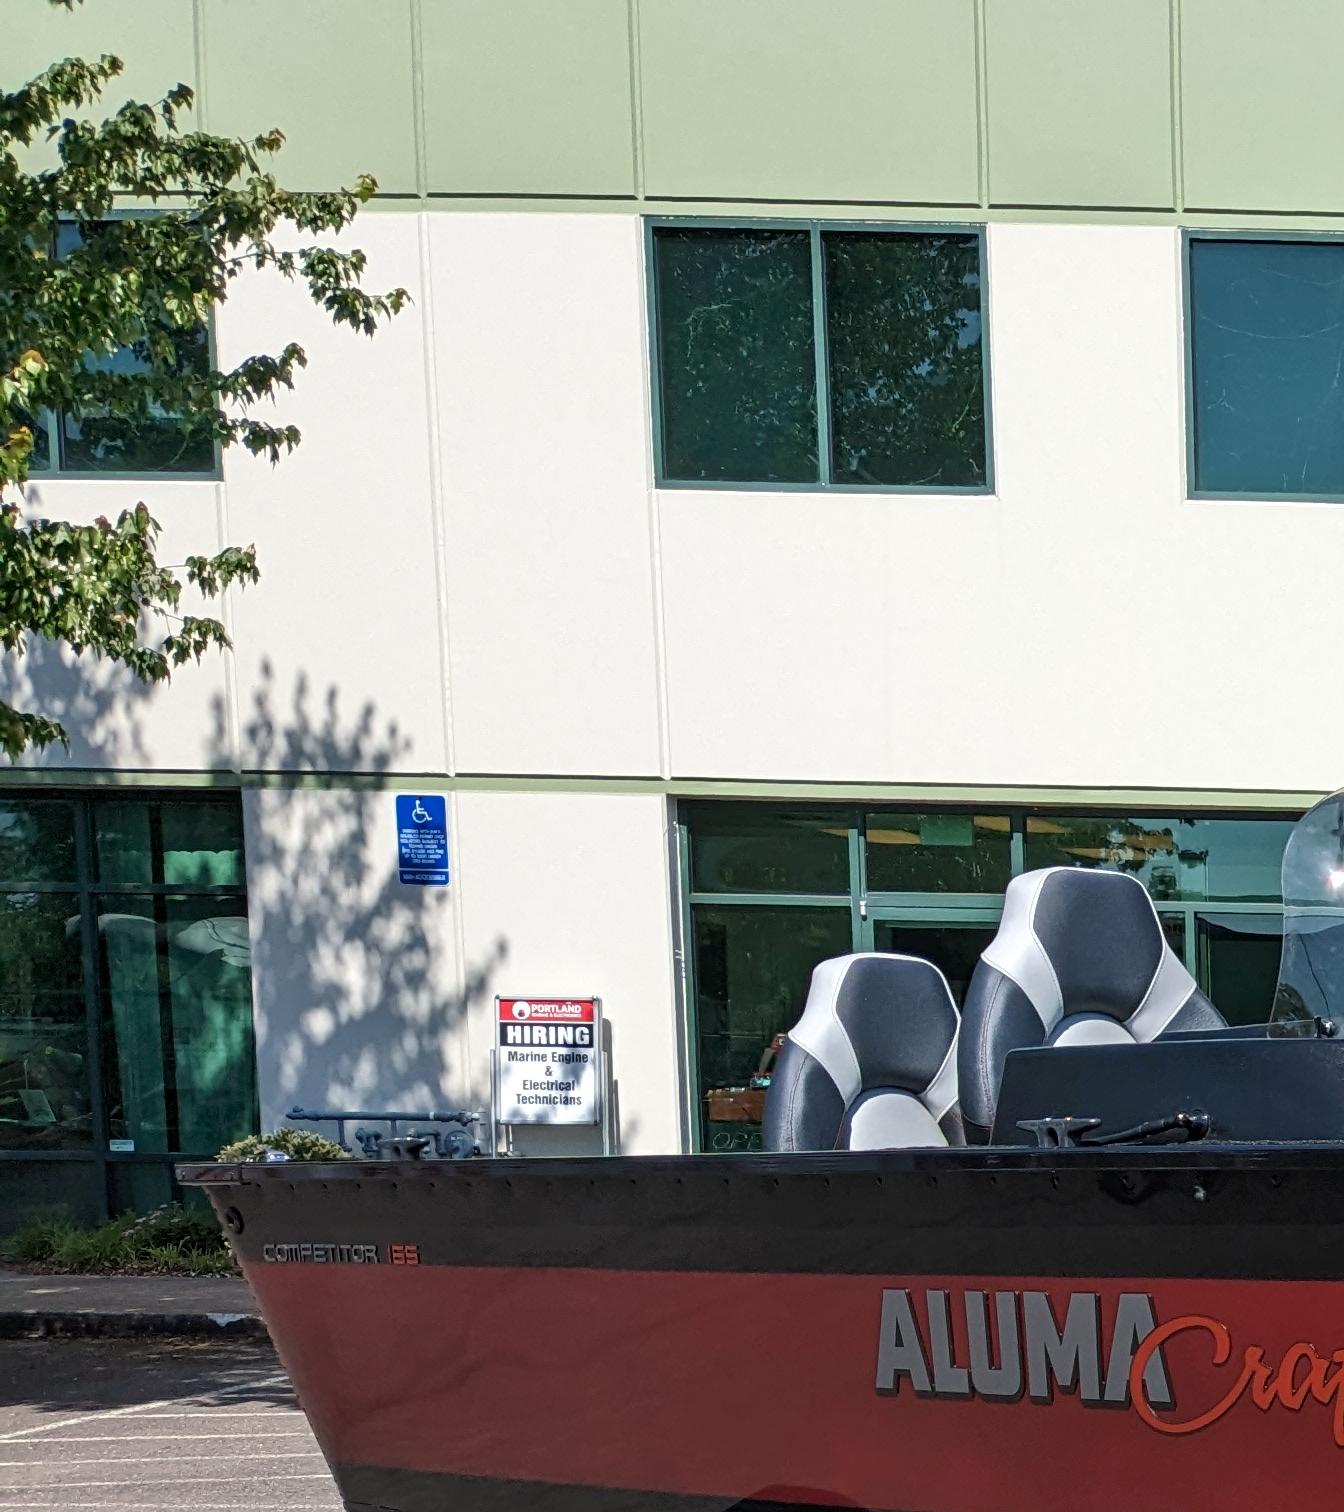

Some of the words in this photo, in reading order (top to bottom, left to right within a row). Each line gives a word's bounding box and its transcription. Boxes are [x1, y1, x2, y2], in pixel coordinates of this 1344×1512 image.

[531, 1004, 582, 1014] PORTLAND
[506, 1025, 590, 1045] HIRING
[507, 1051, 548, 1062] Marine
[551, 1052, 589, 1065] Engine
[544, 1066, 553, 1077] &
[522, 1080, 576, 1092] Electrical
[516, 1094, 583, 1106] Technicians
[263, 1243, 380, 1263] COMPETITOR
